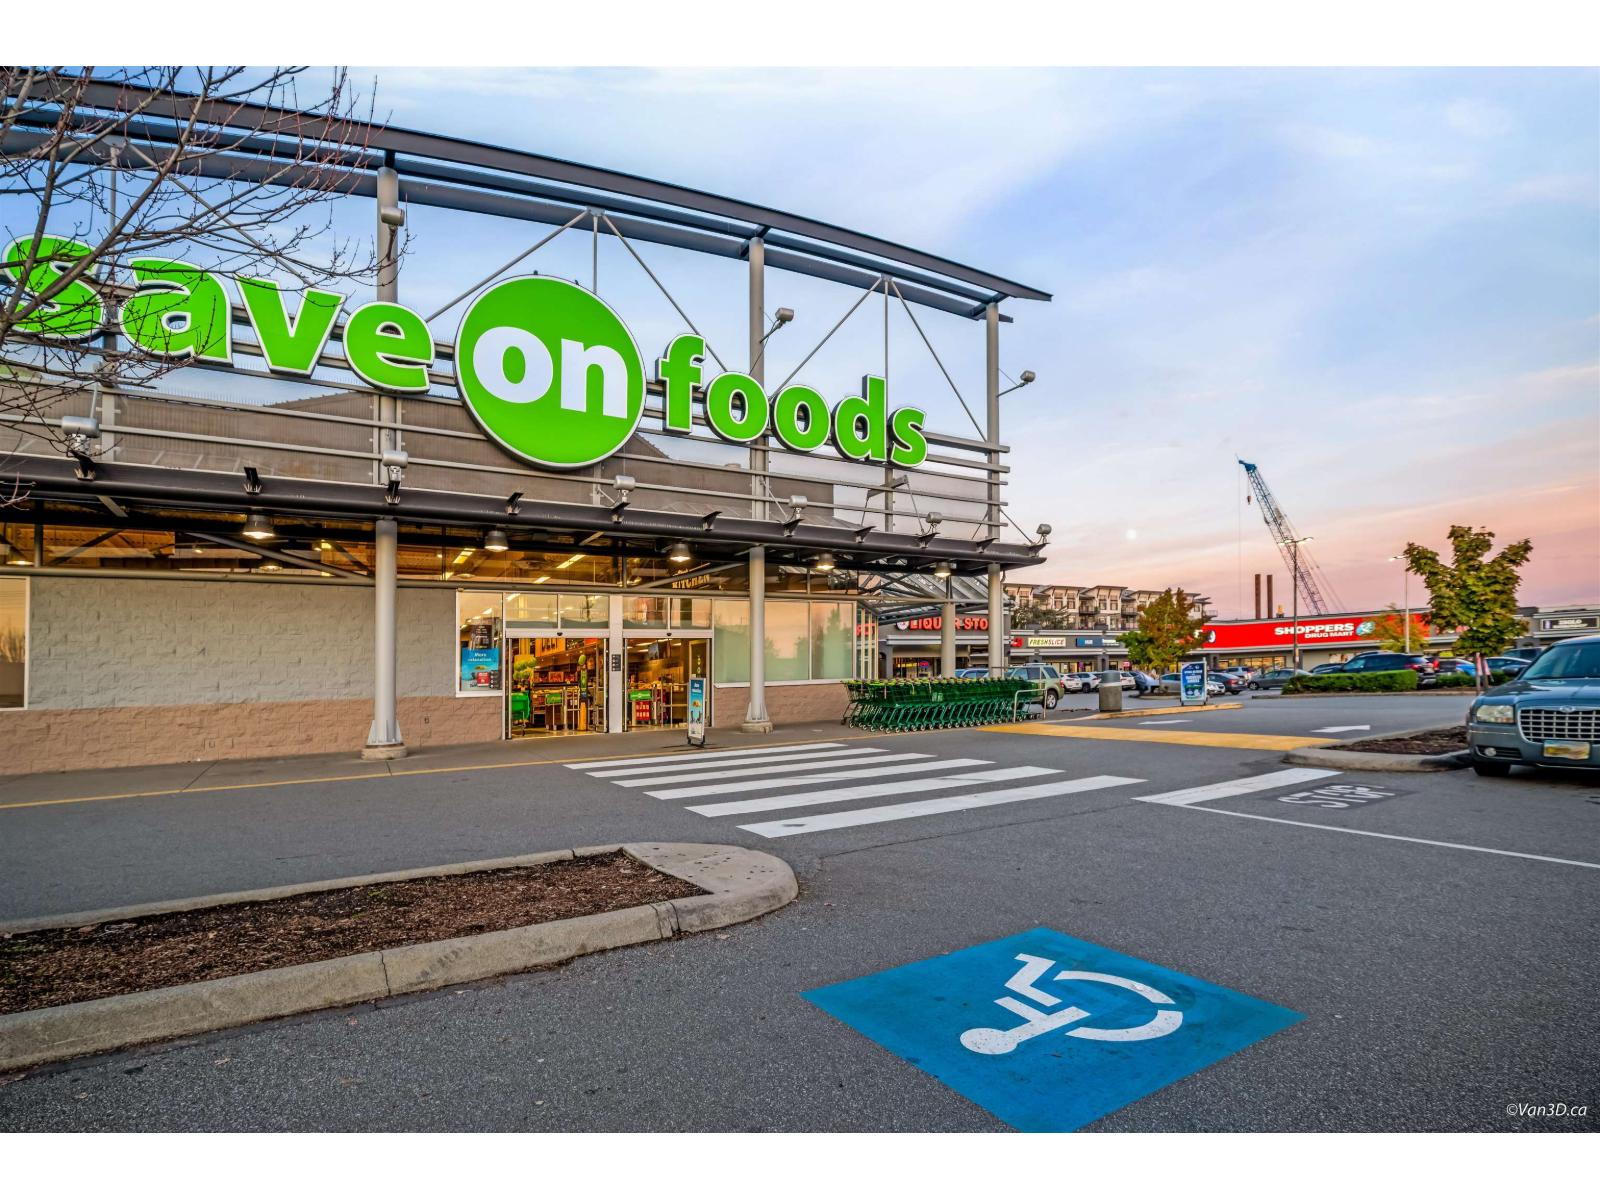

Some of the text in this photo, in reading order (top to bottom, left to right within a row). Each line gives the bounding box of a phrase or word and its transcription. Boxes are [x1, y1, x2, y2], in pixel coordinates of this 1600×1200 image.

[2, 233, 928, 468] save on foods
[672, 574, 710, 589] KITCHEN
[910, 617, 989, 630] LIQUR STO
[1274, 623, 1354, 635] SHOPPERS
[1029, 639, 1065, 647] FRESHSLICE
